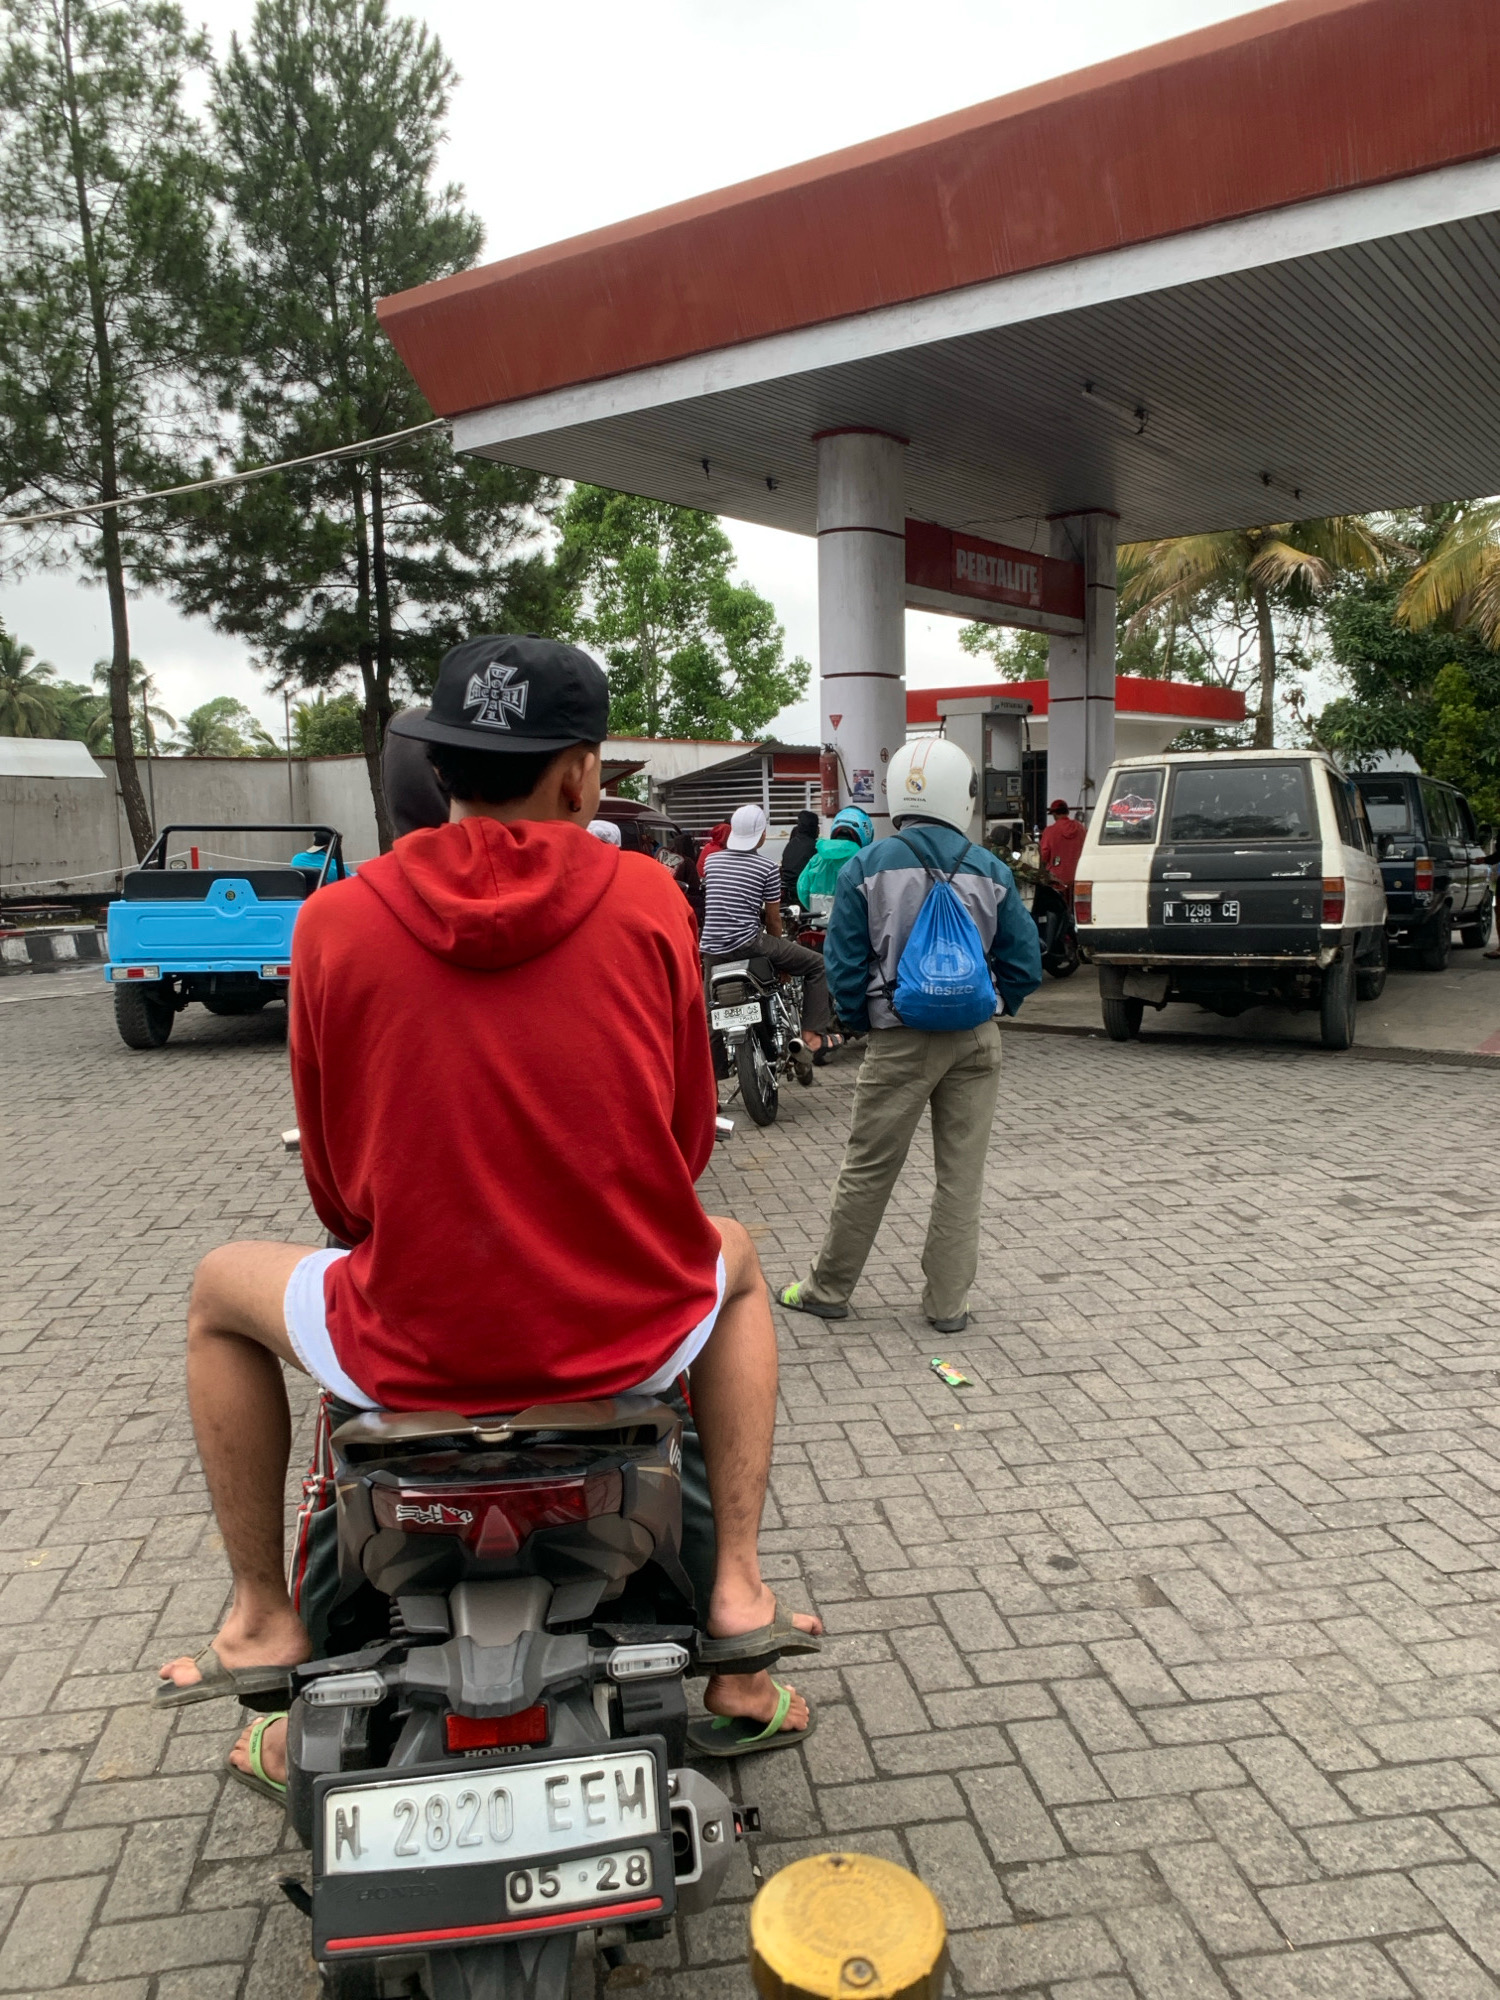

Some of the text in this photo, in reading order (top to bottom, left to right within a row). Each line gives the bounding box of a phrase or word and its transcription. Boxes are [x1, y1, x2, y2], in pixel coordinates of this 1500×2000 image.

[956, 548, 1038, 593] PERTALITE
[1165, 903, 1237, 917] N 1298 CE
[463, 1744, 533, 1758] HONDA
[334, 1765, 648, 1861] N 2820 EEM
